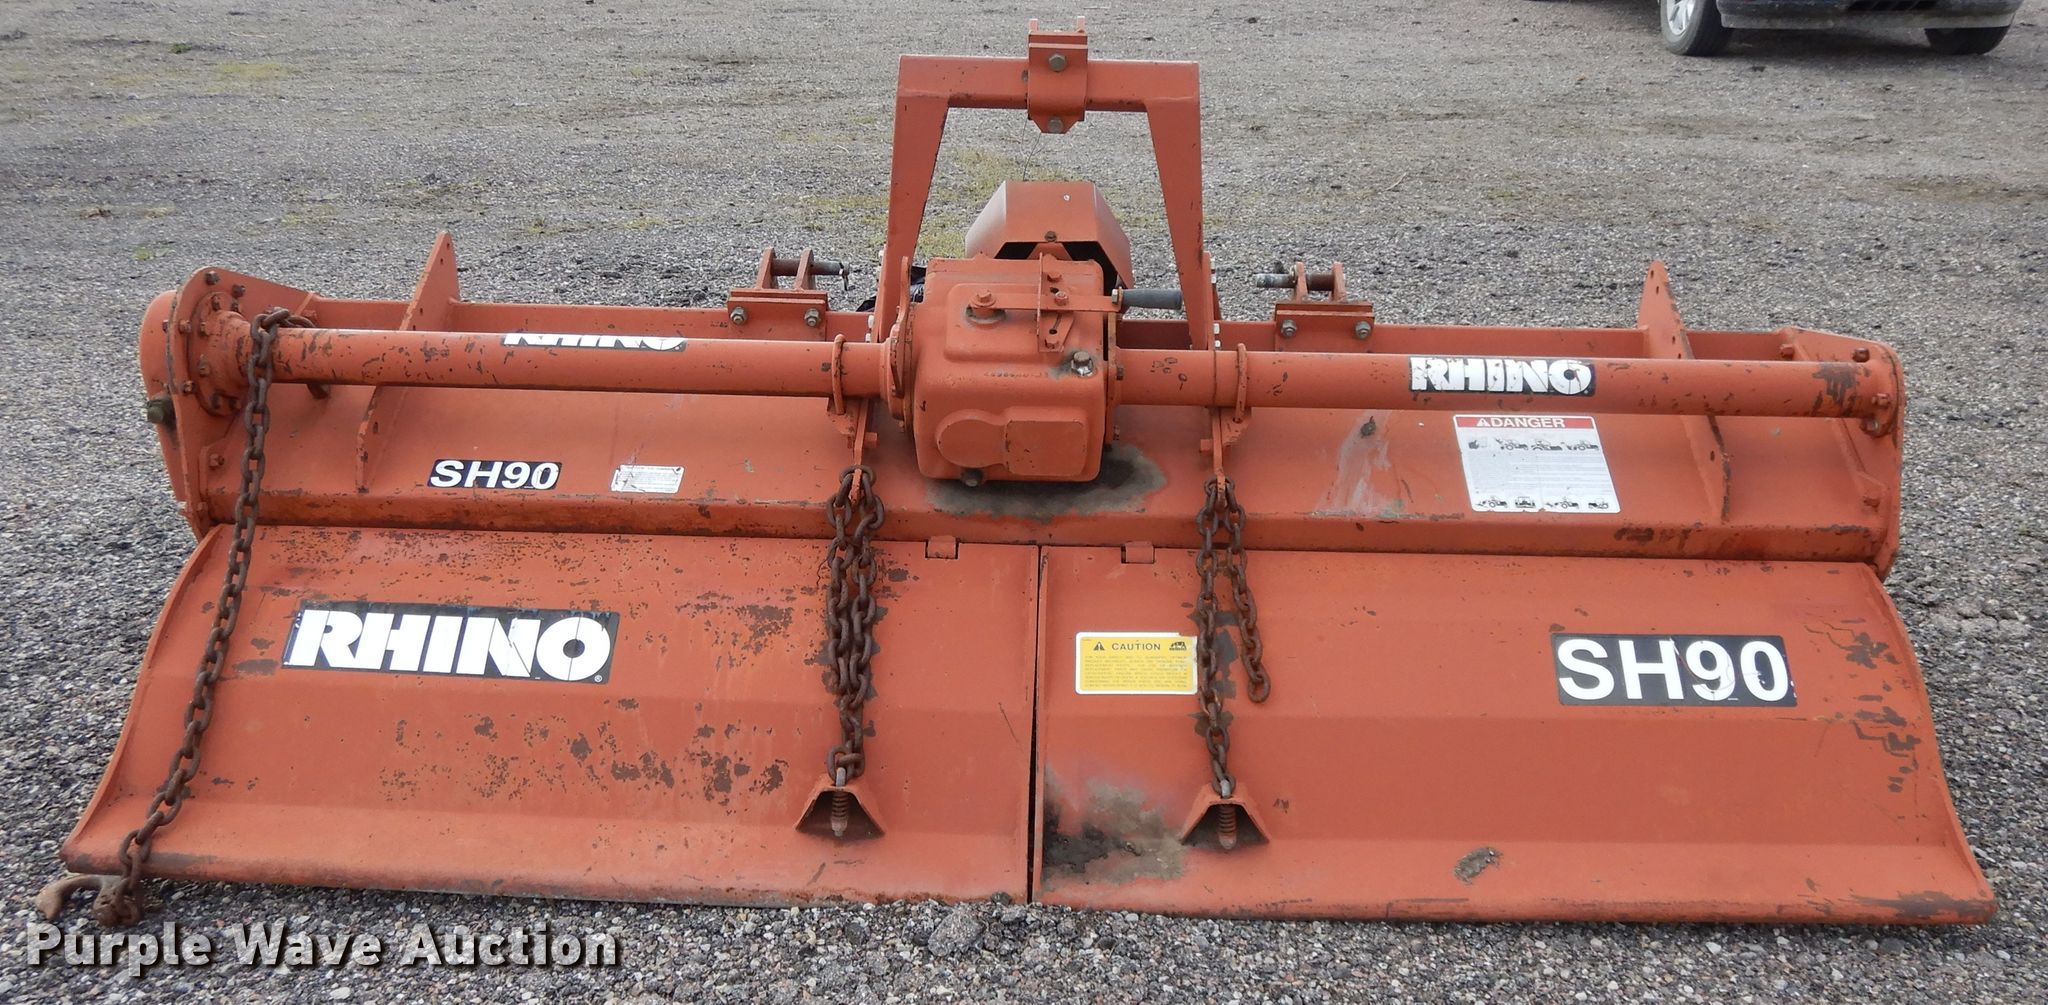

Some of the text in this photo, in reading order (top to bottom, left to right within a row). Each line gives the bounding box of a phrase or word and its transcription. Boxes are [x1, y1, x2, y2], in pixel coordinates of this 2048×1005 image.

[1410, 357, 1592, 395] RHINO
[1490, 417, 1566, 428] DANGER
[430, 460, 559, 490] SH90
[286, 608, 611, 682] RHINO
[1111, 642, 1161, 651] CAUTION
[1557, 638, 1789, 702] SH90
